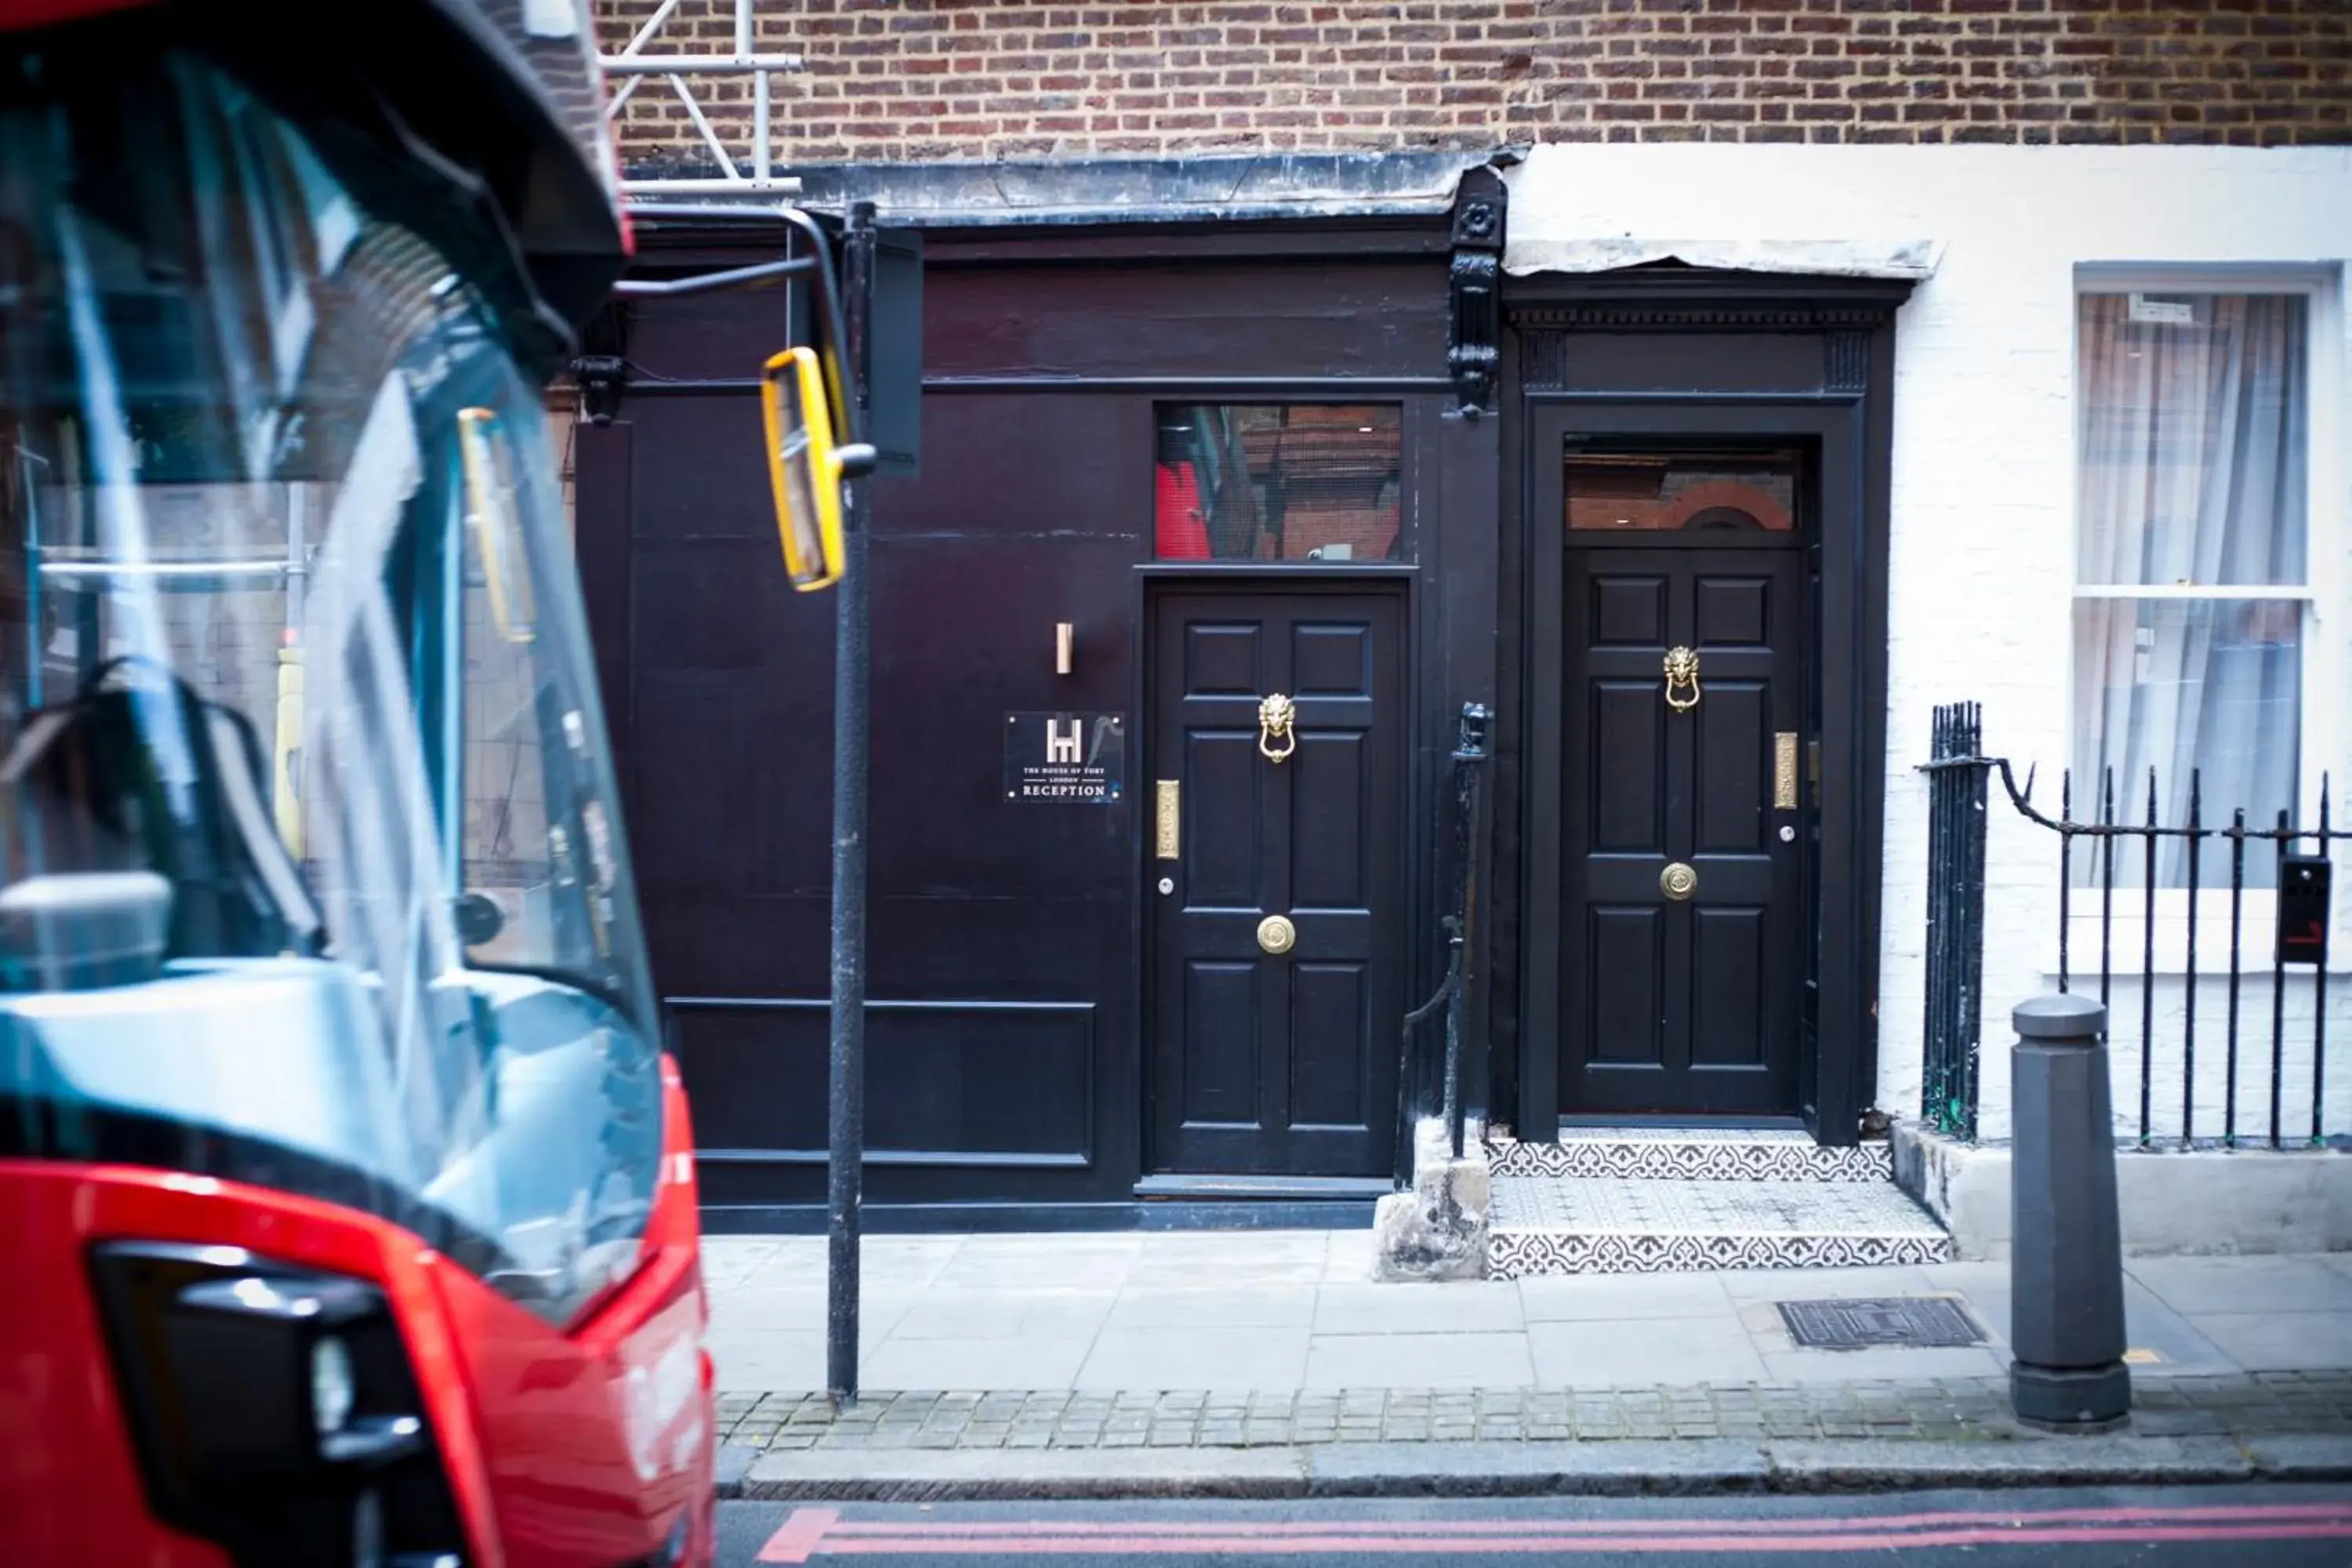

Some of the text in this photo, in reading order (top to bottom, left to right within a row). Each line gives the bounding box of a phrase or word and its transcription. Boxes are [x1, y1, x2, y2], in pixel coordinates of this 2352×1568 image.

[1023, 767, 1040, 775] THE
[1070, 767, 1081, 775] OF
[1023, 786, 1105, 797] RECEPTION
